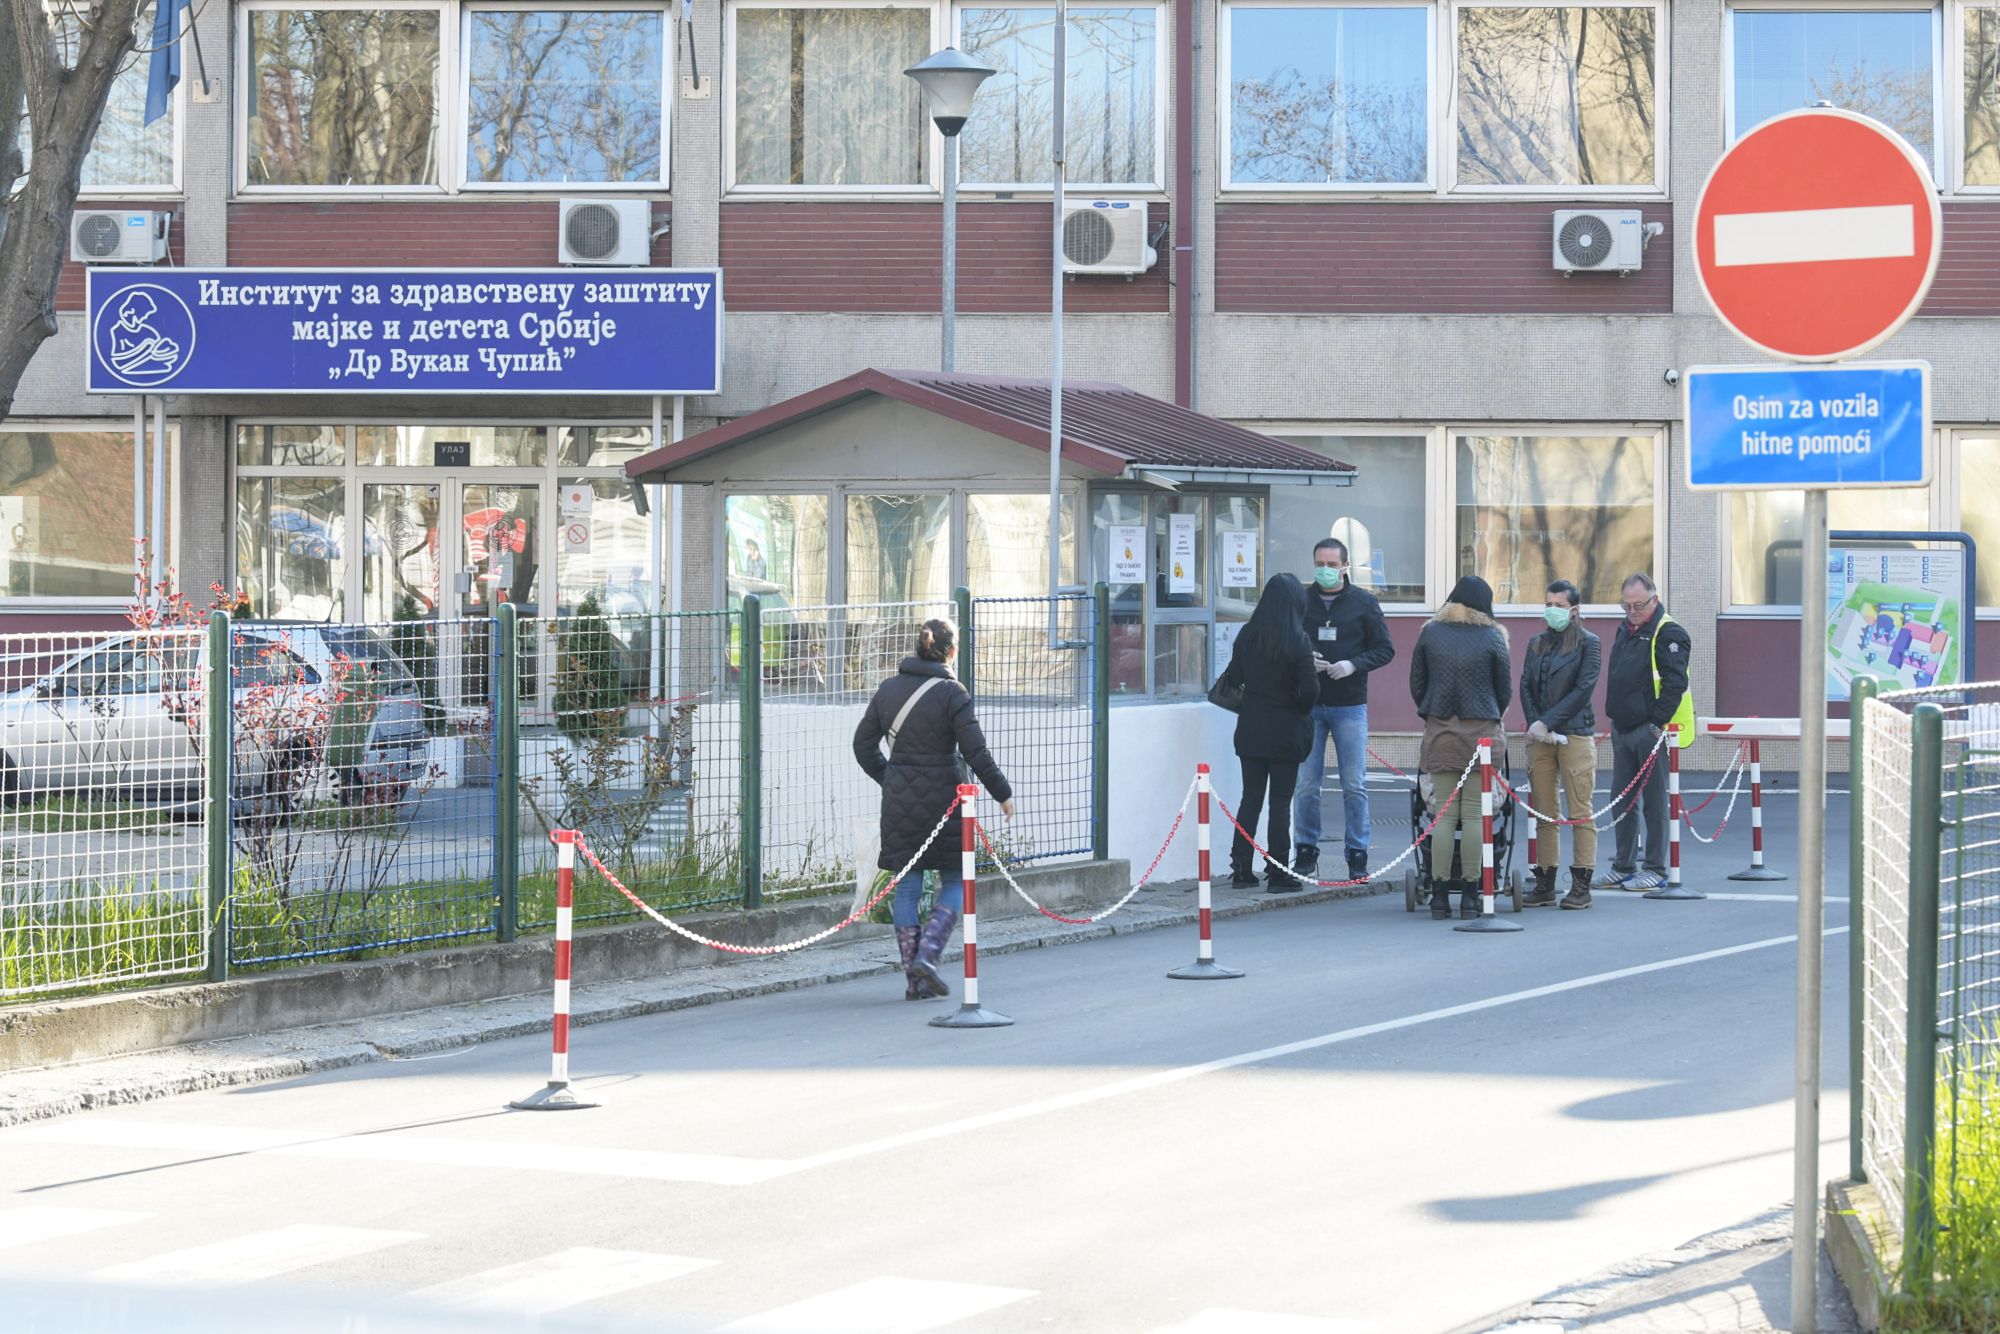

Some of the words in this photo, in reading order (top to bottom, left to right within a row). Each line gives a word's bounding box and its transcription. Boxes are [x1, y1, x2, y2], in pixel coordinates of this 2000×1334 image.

[198, 279, 342, 313] Институт
[351, 284, 381, 305] за
[390, 283, 575, 312] здравствену
[583, 281, 712, 311] заштиту
[292, 313, 373, 348] мајке
[382, 320, 401, 340] и
[408, 318, 511, 344] детета
[518, 310, 617, 347] Србије
[390, 354, 470, 380] Вукан
[1732, 394, 1784, 420] Osim
[1789, 399, 1814, 419] za
[1820, 392, 1879, 418] vozila
[441, 445, 464, 454] УЛАЗ
[450, 455, 455, 463] 1
[1742, 430, 1794, 456] hitne
[1798, 429, 1871, 461] pomoći
